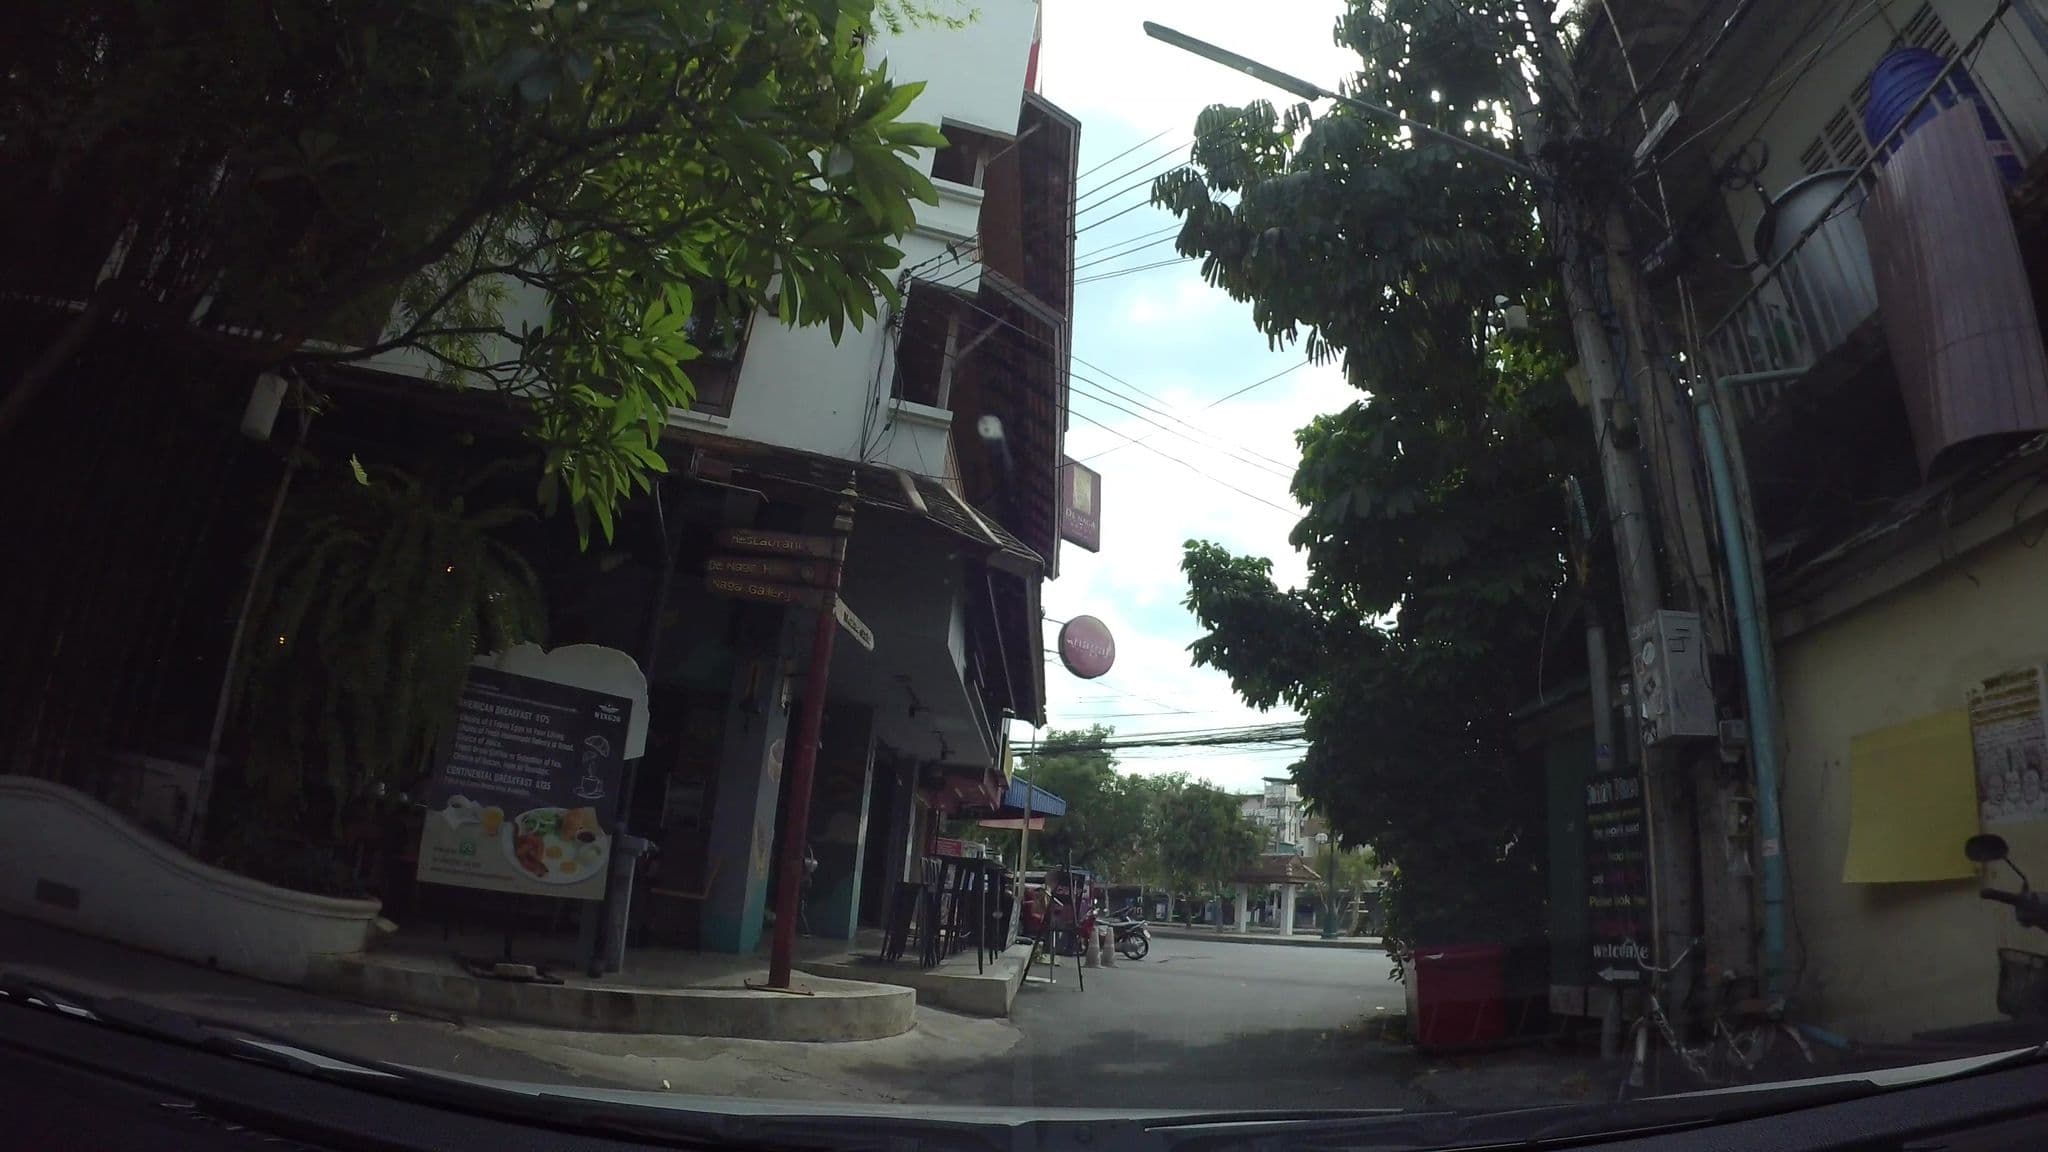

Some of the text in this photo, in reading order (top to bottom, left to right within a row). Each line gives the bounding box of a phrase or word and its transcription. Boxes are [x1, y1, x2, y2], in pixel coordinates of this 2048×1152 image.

[712, 578, 742, 592] Naga
[494, 705, 533, 721] BREAKFAST
[446, 765, 493, 781] CONTINENTAL
[493, 773, 532, 787] BREAKFAST
